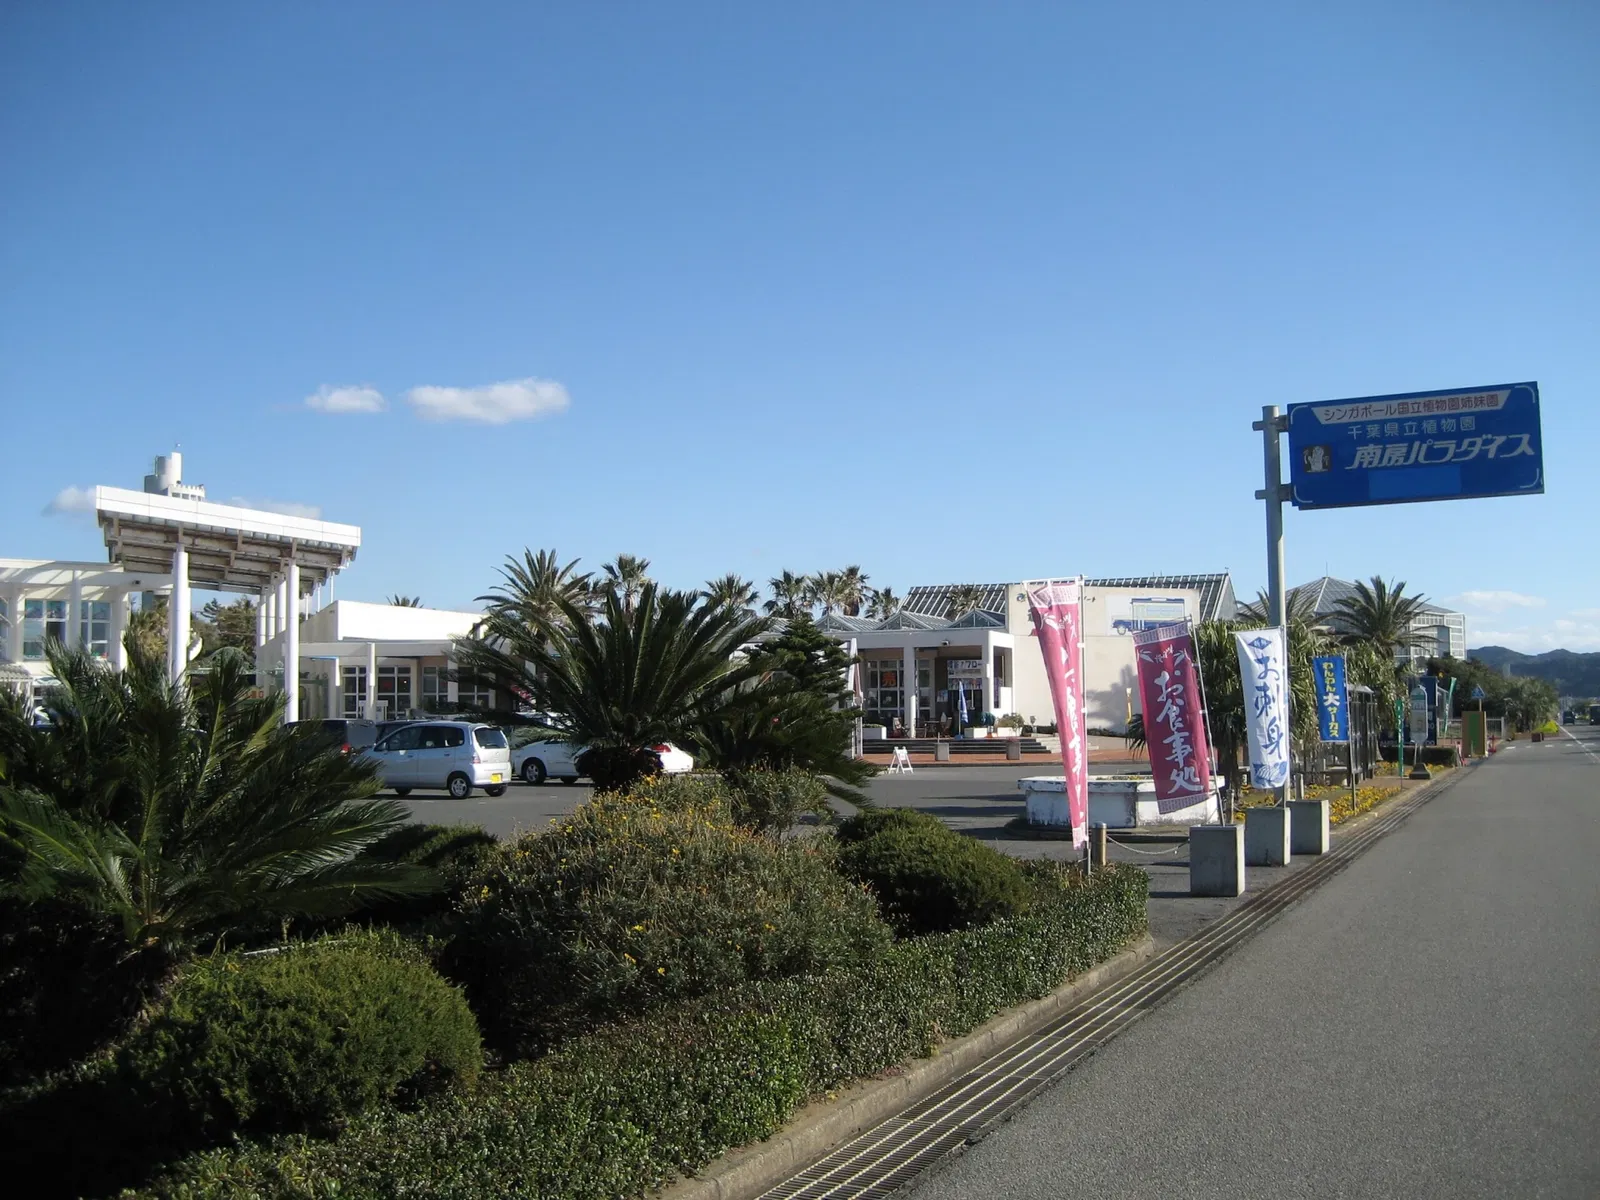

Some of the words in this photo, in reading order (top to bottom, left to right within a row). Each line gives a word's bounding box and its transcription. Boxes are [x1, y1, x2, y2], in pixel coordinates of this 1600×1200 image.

[1344, 433, 1535, 470] 南房パラダイス
[1347, 415, 1476, 440] 千葉県立植物園
[1154, 670, 1204, 795] お食事処
[1254, 653, 1284, 760] お刺身
[1322, 662, 1341, 738] わんわん大サーカス
